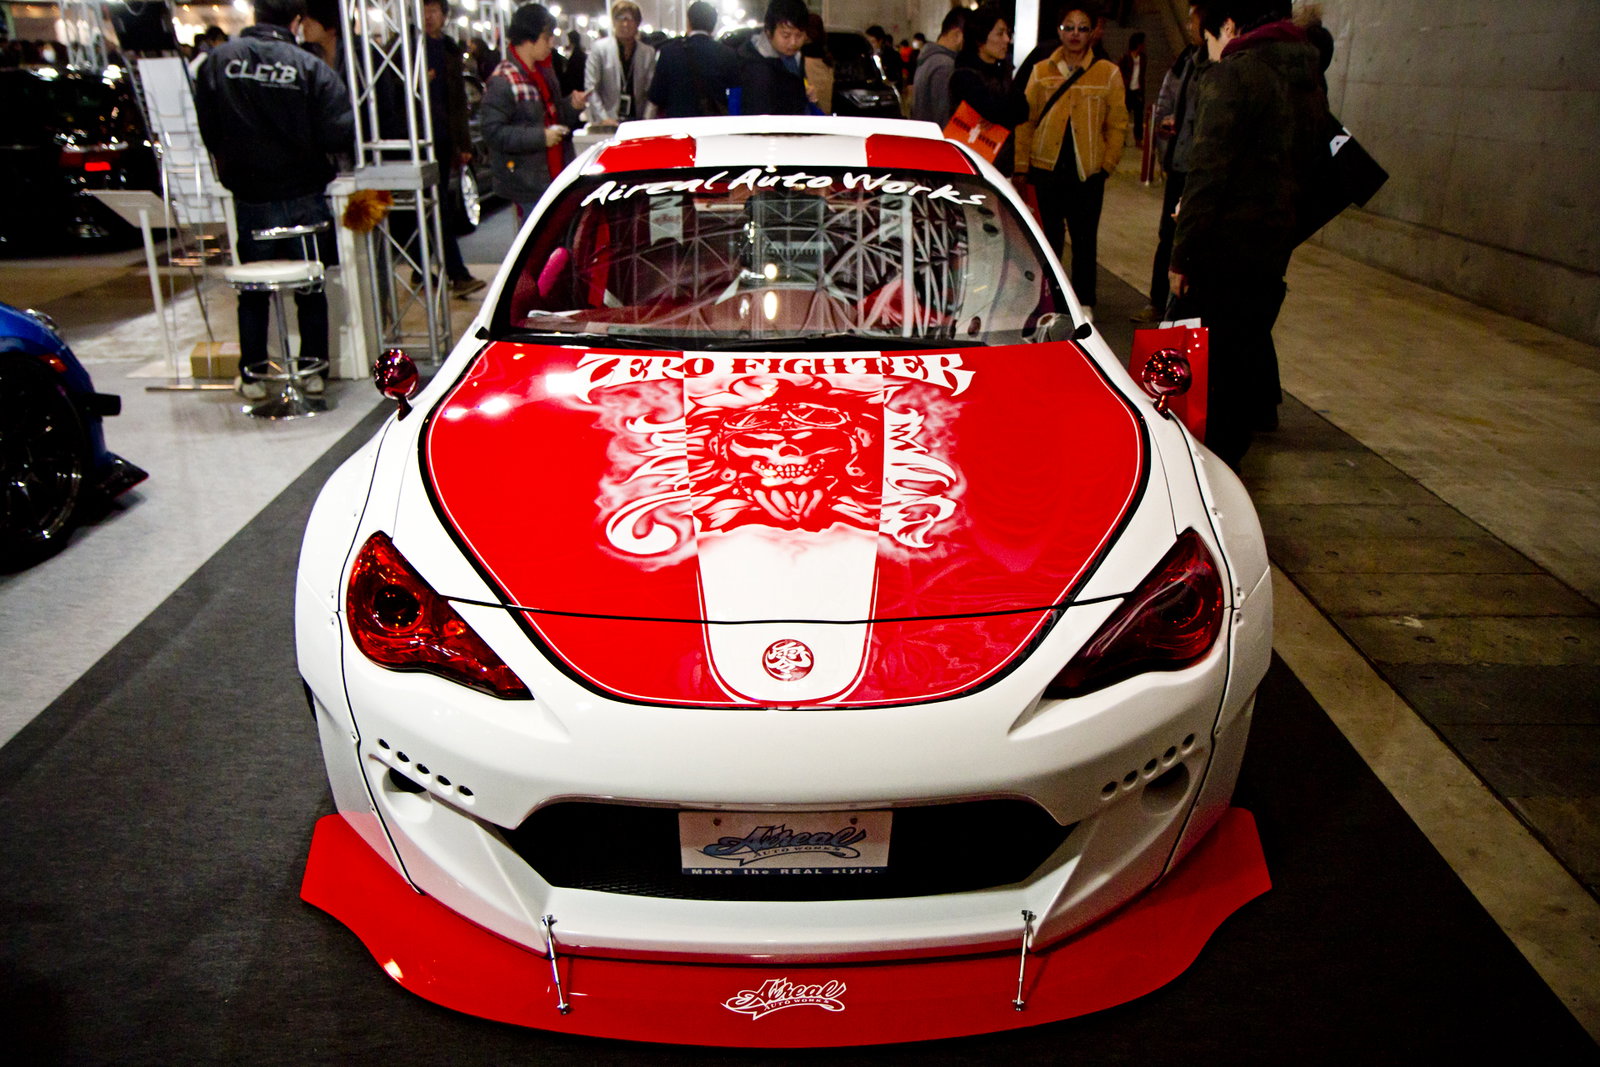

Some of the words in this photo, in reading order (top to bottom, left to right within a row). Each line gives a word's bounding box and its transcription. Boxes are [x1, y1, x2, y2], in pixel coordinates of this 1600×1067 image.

[728, 167, 833, 191] Auto
[843, 172, 987, 206] Works
[576, 353, 715, 404] ZERO
[731, 353, 976, 397] FIGHTER
